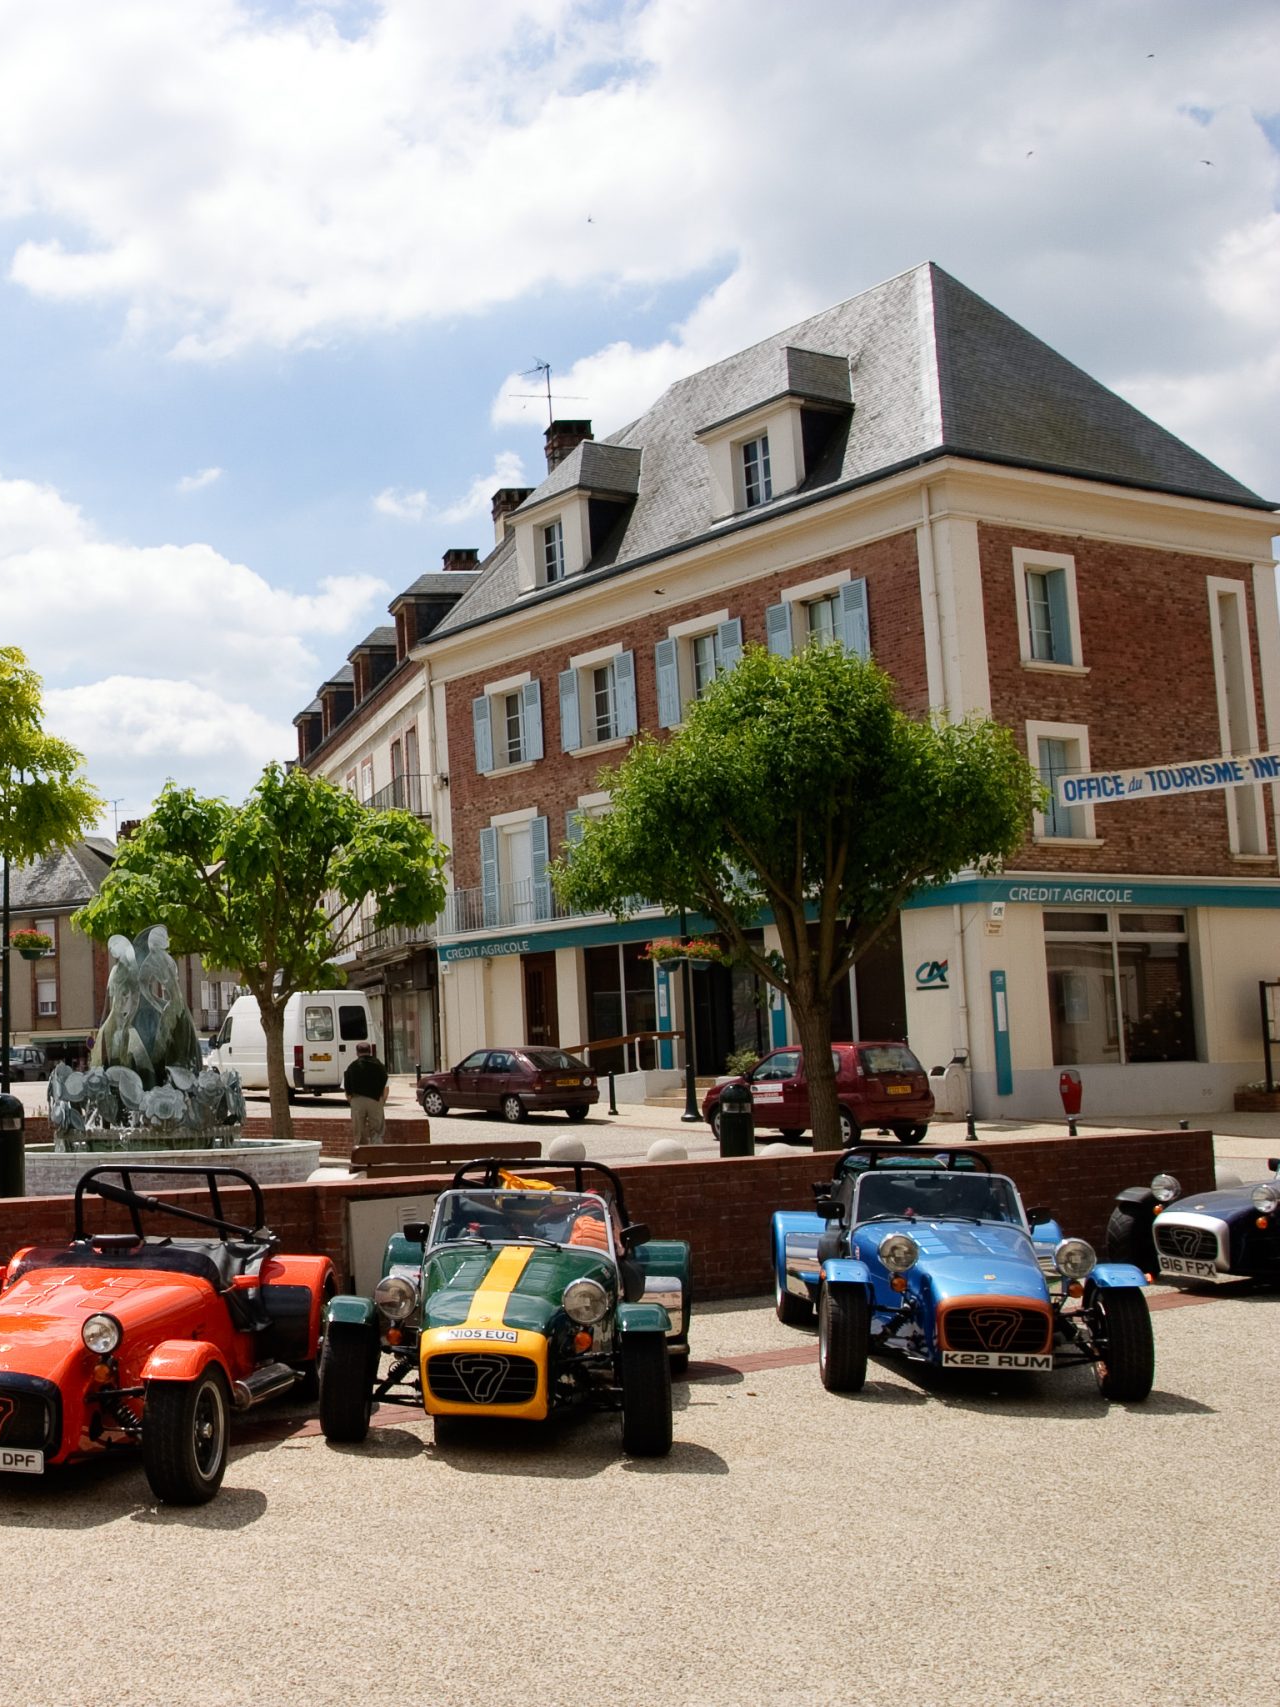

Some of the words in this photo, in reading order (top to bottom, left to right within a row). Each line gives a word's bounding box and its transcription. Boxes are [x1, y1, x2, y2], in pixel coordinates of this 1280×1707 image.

[1063, 775, 1125, 801] OFFICE
[1128, 776, 1143, 793] du
[1145, 761, 1244, 791] TOURISME
[1063, 888, 1133, 902] AGRICOLE
[480, 940, 531, 956] AGRICOLE
[1173, 1229, 1199, 1256] 7
[1160, 1257, 1183, 1272] 816
[1185, 1260, 1217, 1277] FPX
[450, 1329, 482, 1338] N105
[485, 1331, 515, 1340] EUG
[975, 1312, 1017, 1347] 7
[944, 1353, 989, 1366] K22
[998, 1355, 1051, 1369] RUM
[459, 1358, 503, 1397] 7
[2, 1452, 36, 1467] DPF
